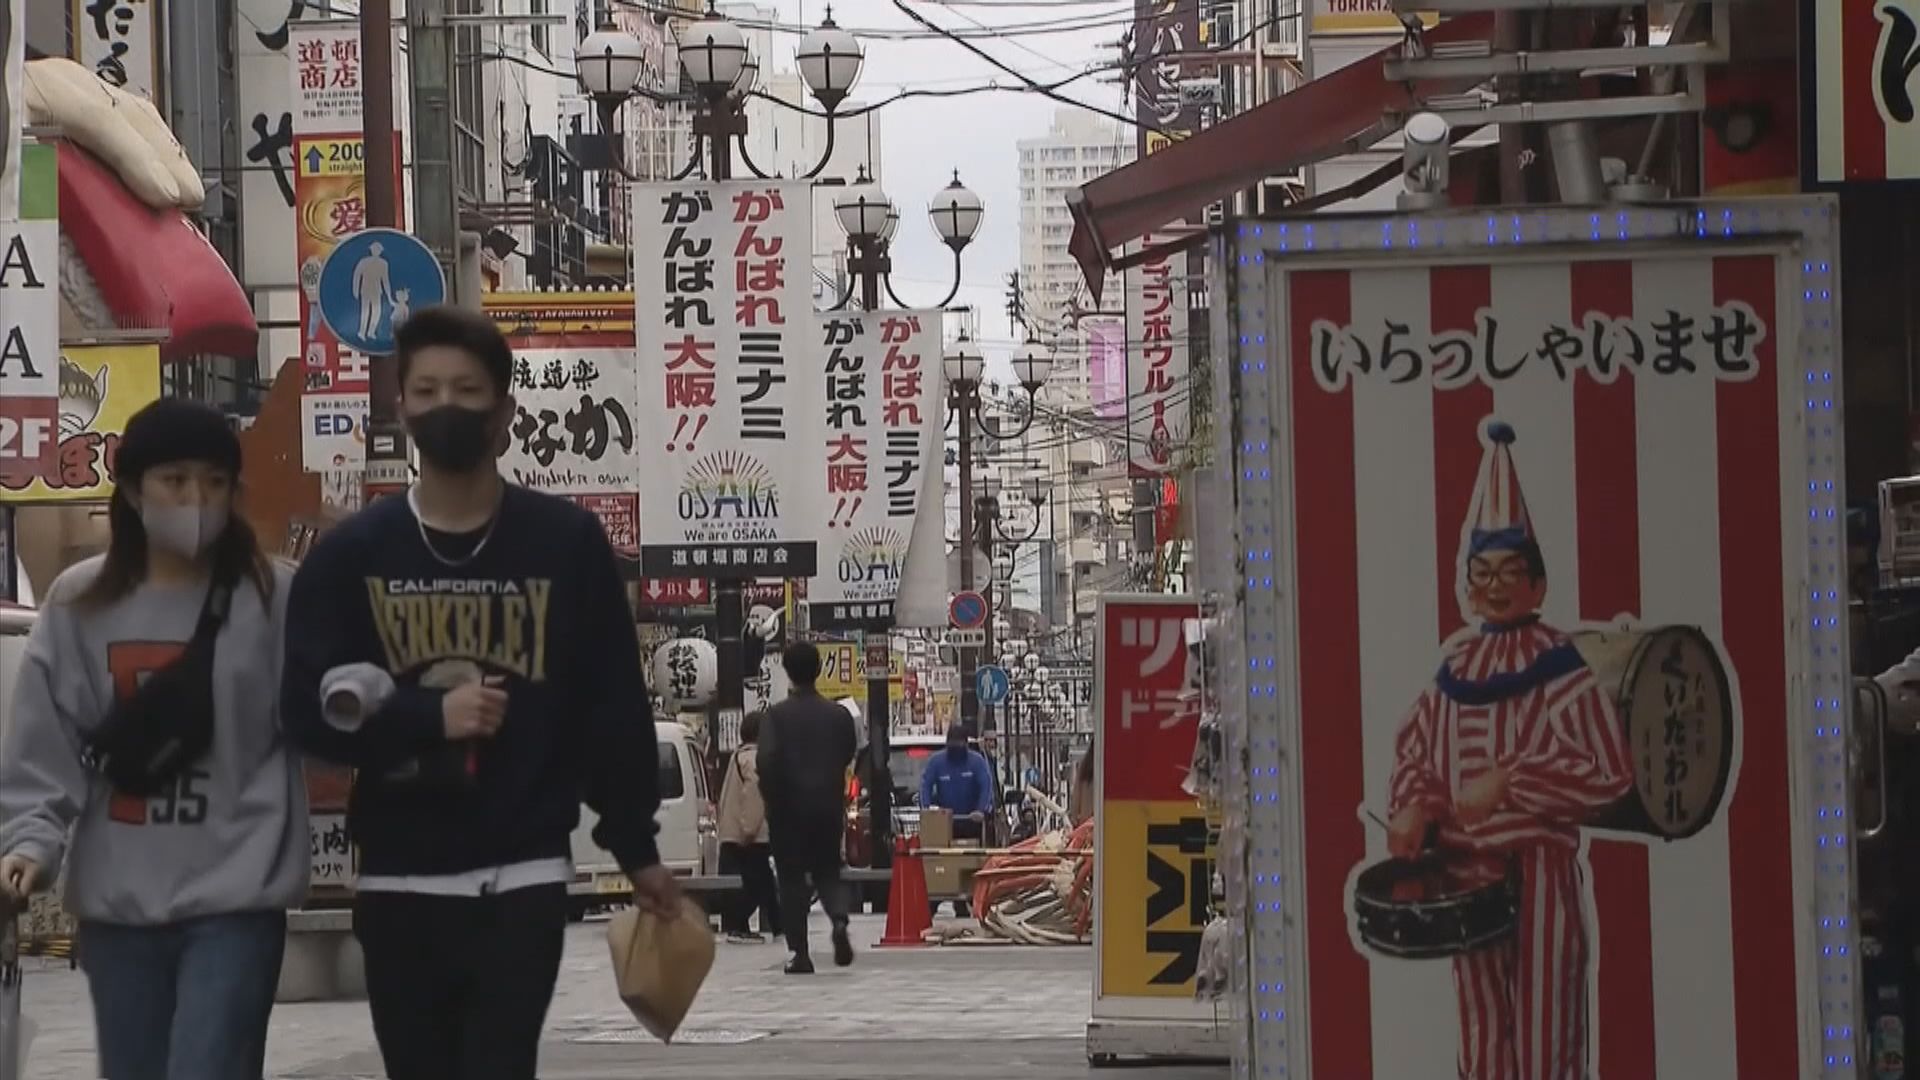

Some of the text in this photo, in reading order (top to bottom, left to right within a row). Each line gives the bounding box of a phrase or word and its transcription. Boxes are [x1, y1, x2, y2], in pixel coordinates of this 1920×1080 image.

[731, 188, 787, 441] がんばれミナミ
[1319, 308, 1757, 383] いらっしゃいませ
[880, 315, 923, 517] がんばれミナミ
[678, 467, 779, 520] OSAKA
[684, 528, 778, 541] We are OSAKA
[388, 578, 520, 594] CALIFORNIA
